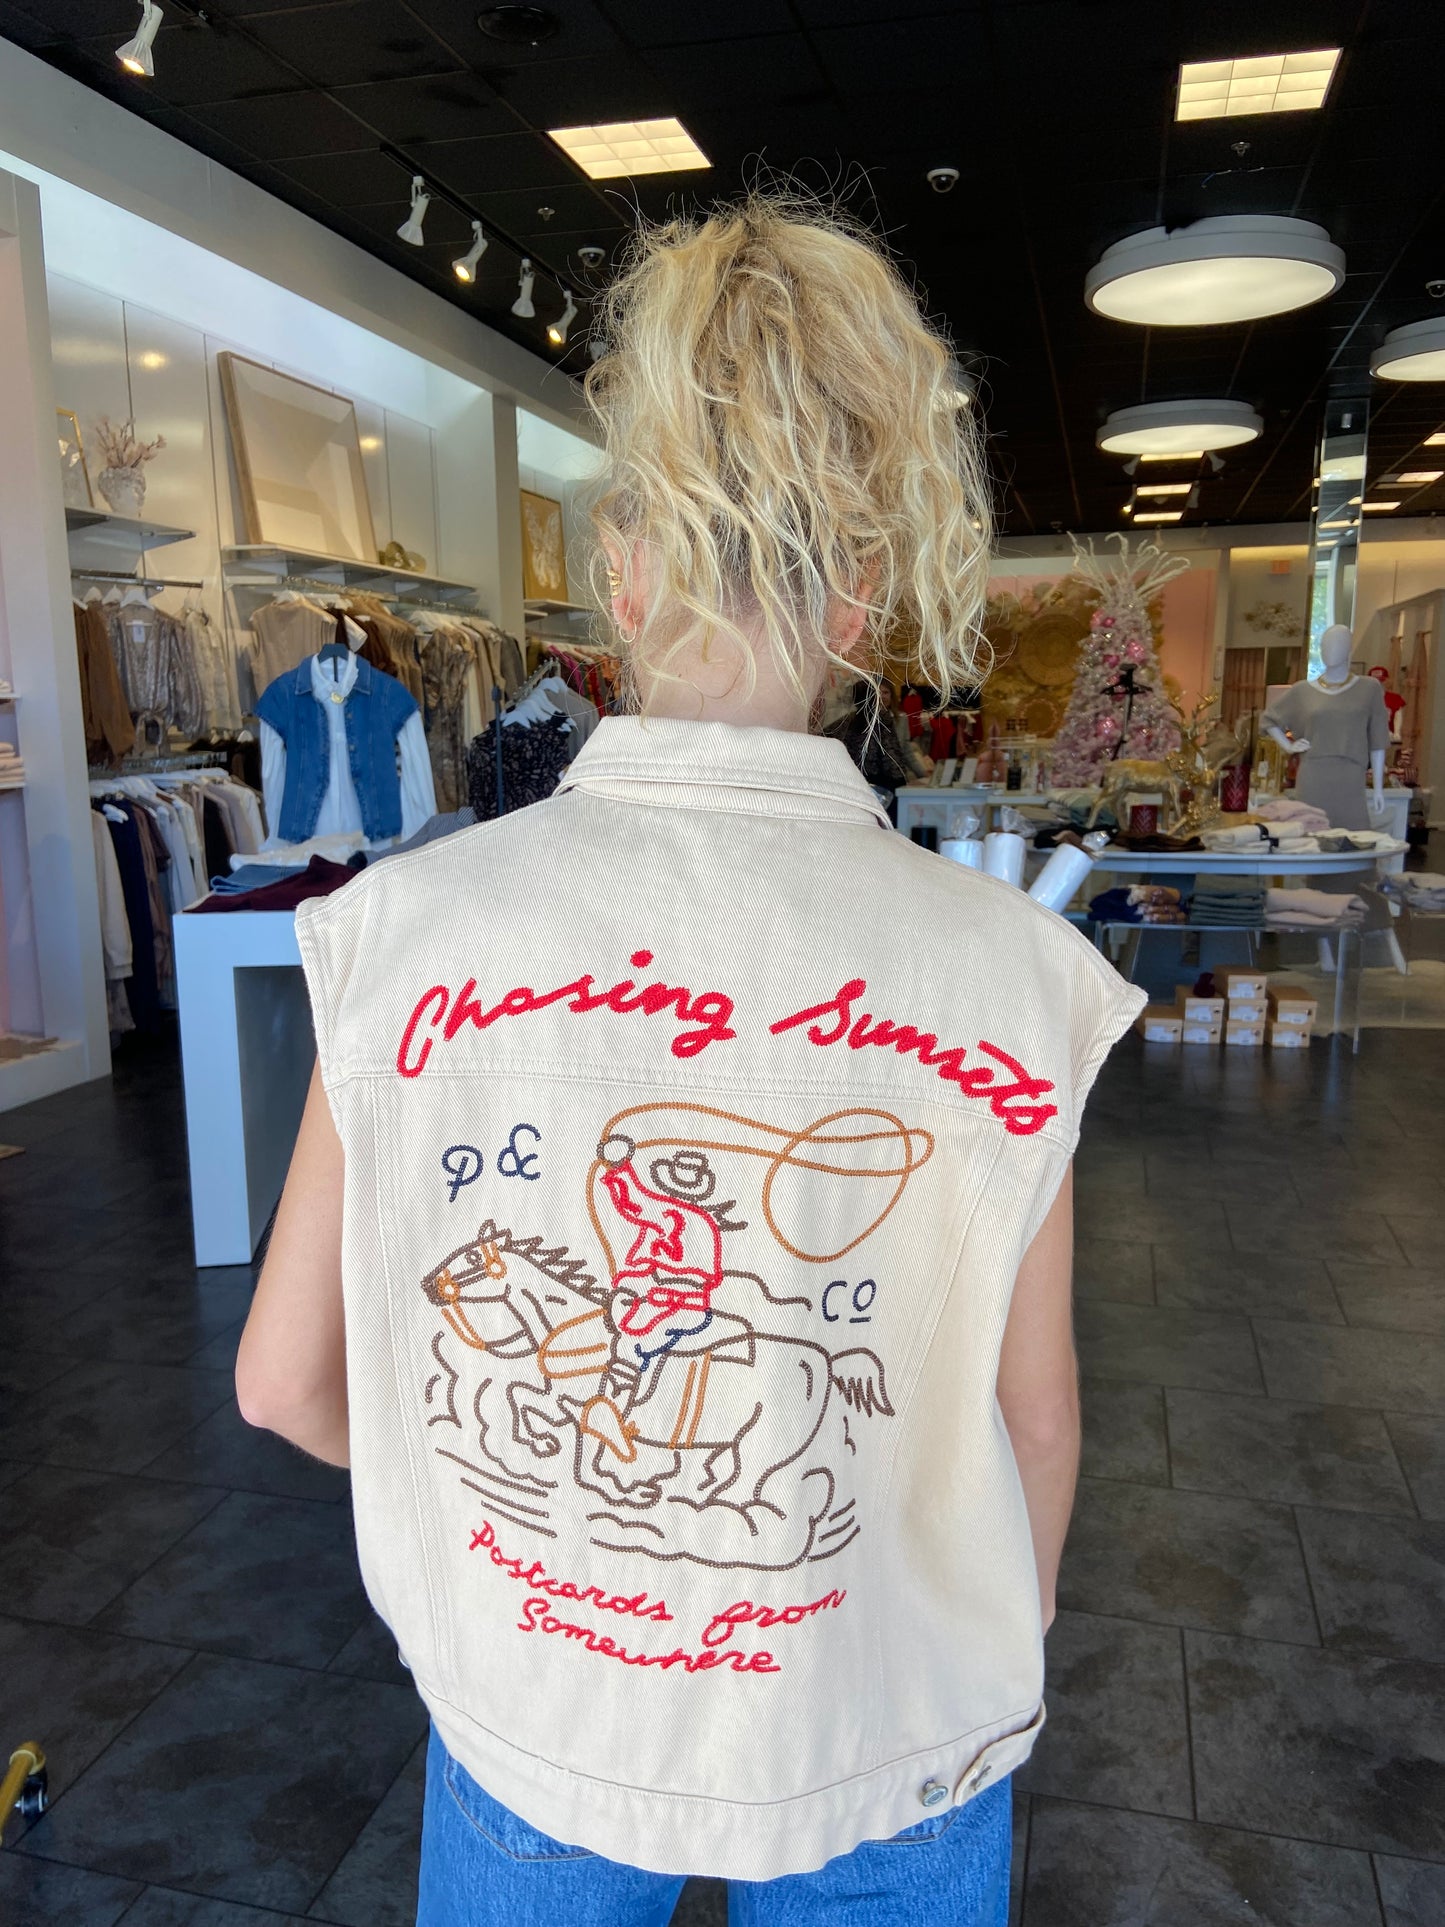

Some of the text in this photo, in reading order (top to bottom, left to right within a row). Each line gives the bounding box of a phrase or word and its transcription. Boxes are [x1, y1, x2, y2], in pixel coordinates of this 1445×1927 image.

[397, 949, 1059, 1137] Chasing Sunsets
[468, 1520, 847, 1648] Postcards from
[517, 1597, 781, 1674] Somewhere
